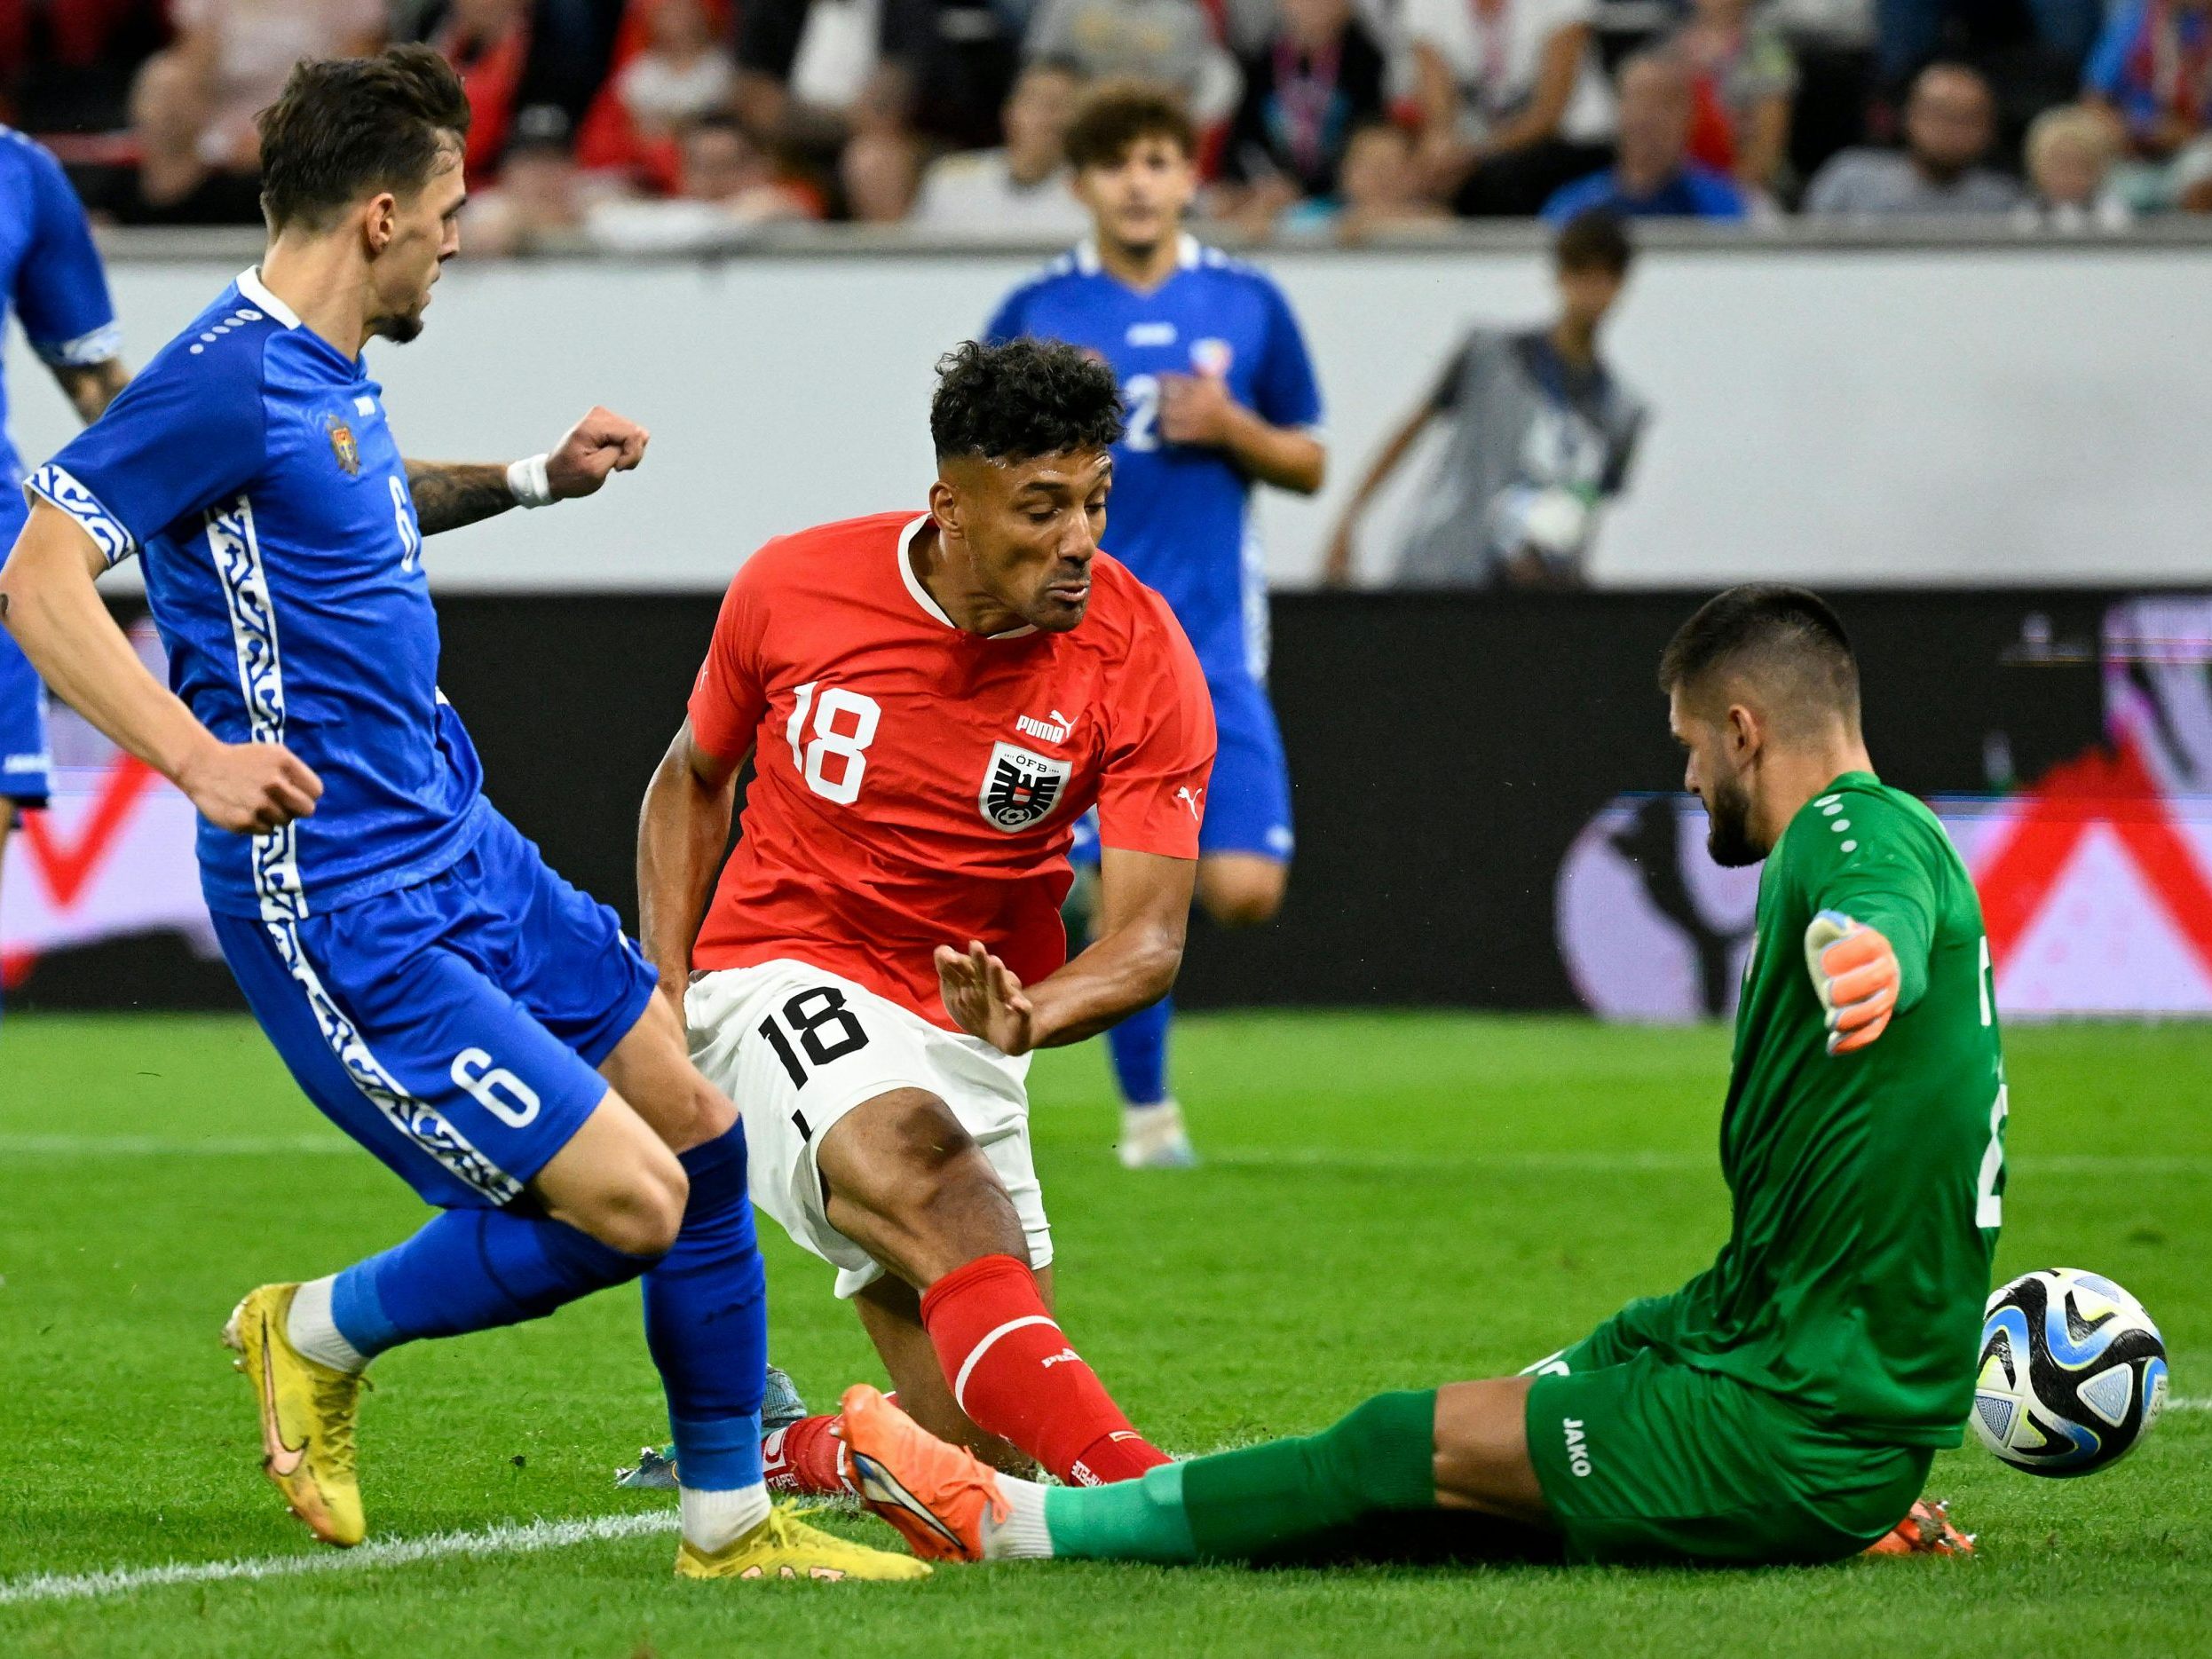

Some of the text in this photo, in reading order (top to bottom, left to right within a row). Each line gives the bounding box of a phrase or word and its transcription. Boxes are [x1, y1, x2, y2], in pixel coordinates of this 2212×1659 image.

[786, 681, 881, 805] 18
[1015, 715, 1065, 744] PUMA
[1015, 754, 1047, 773] ÖFB
[757, 986, 870, 1091] 18
[450, 1047, 541, 1129] 6
[1563, 1418, 1592, 1477] JAKO
